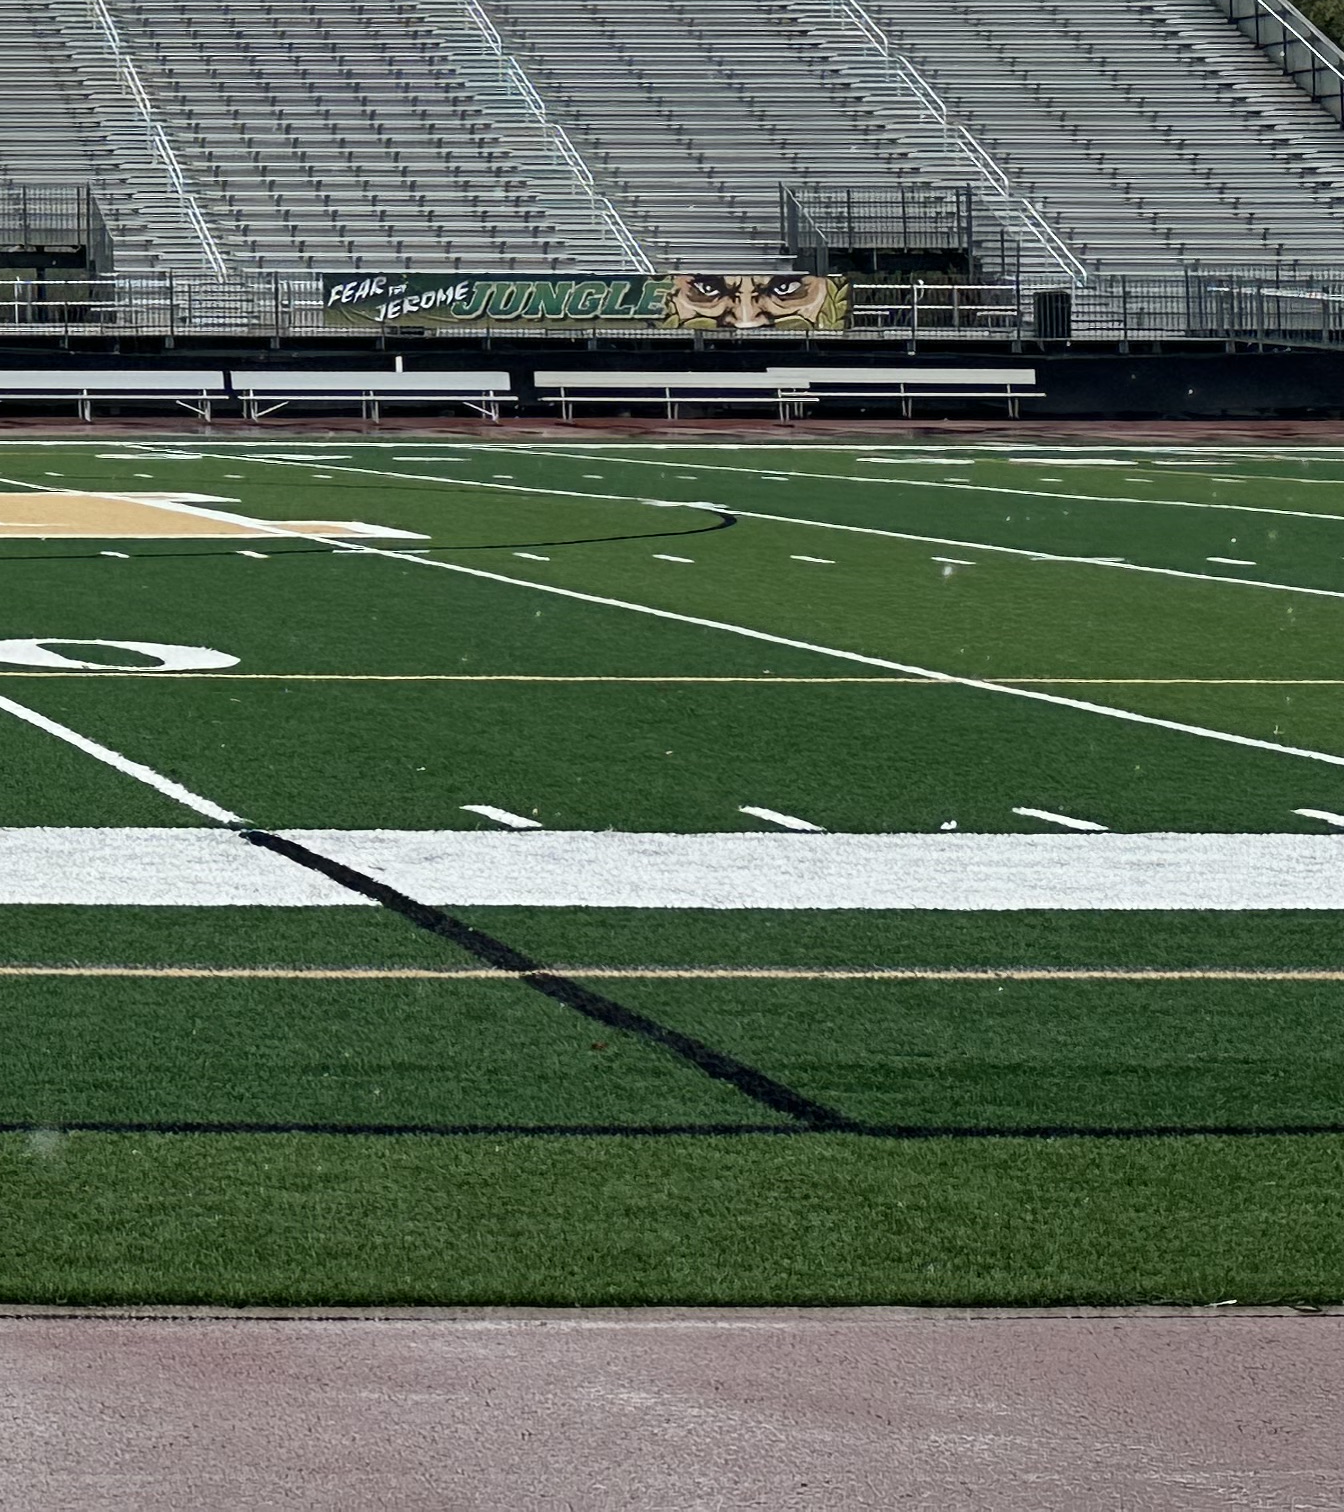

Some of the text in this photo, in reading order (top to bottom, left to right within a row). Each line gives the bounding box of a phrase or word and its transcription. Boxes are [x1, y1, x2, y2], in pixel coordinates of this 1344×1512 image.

[327, 276, 387, 307] FEAR
[374, 280, 469, 322] JEROME
[450, 280, 675, 320] JUNGLE
